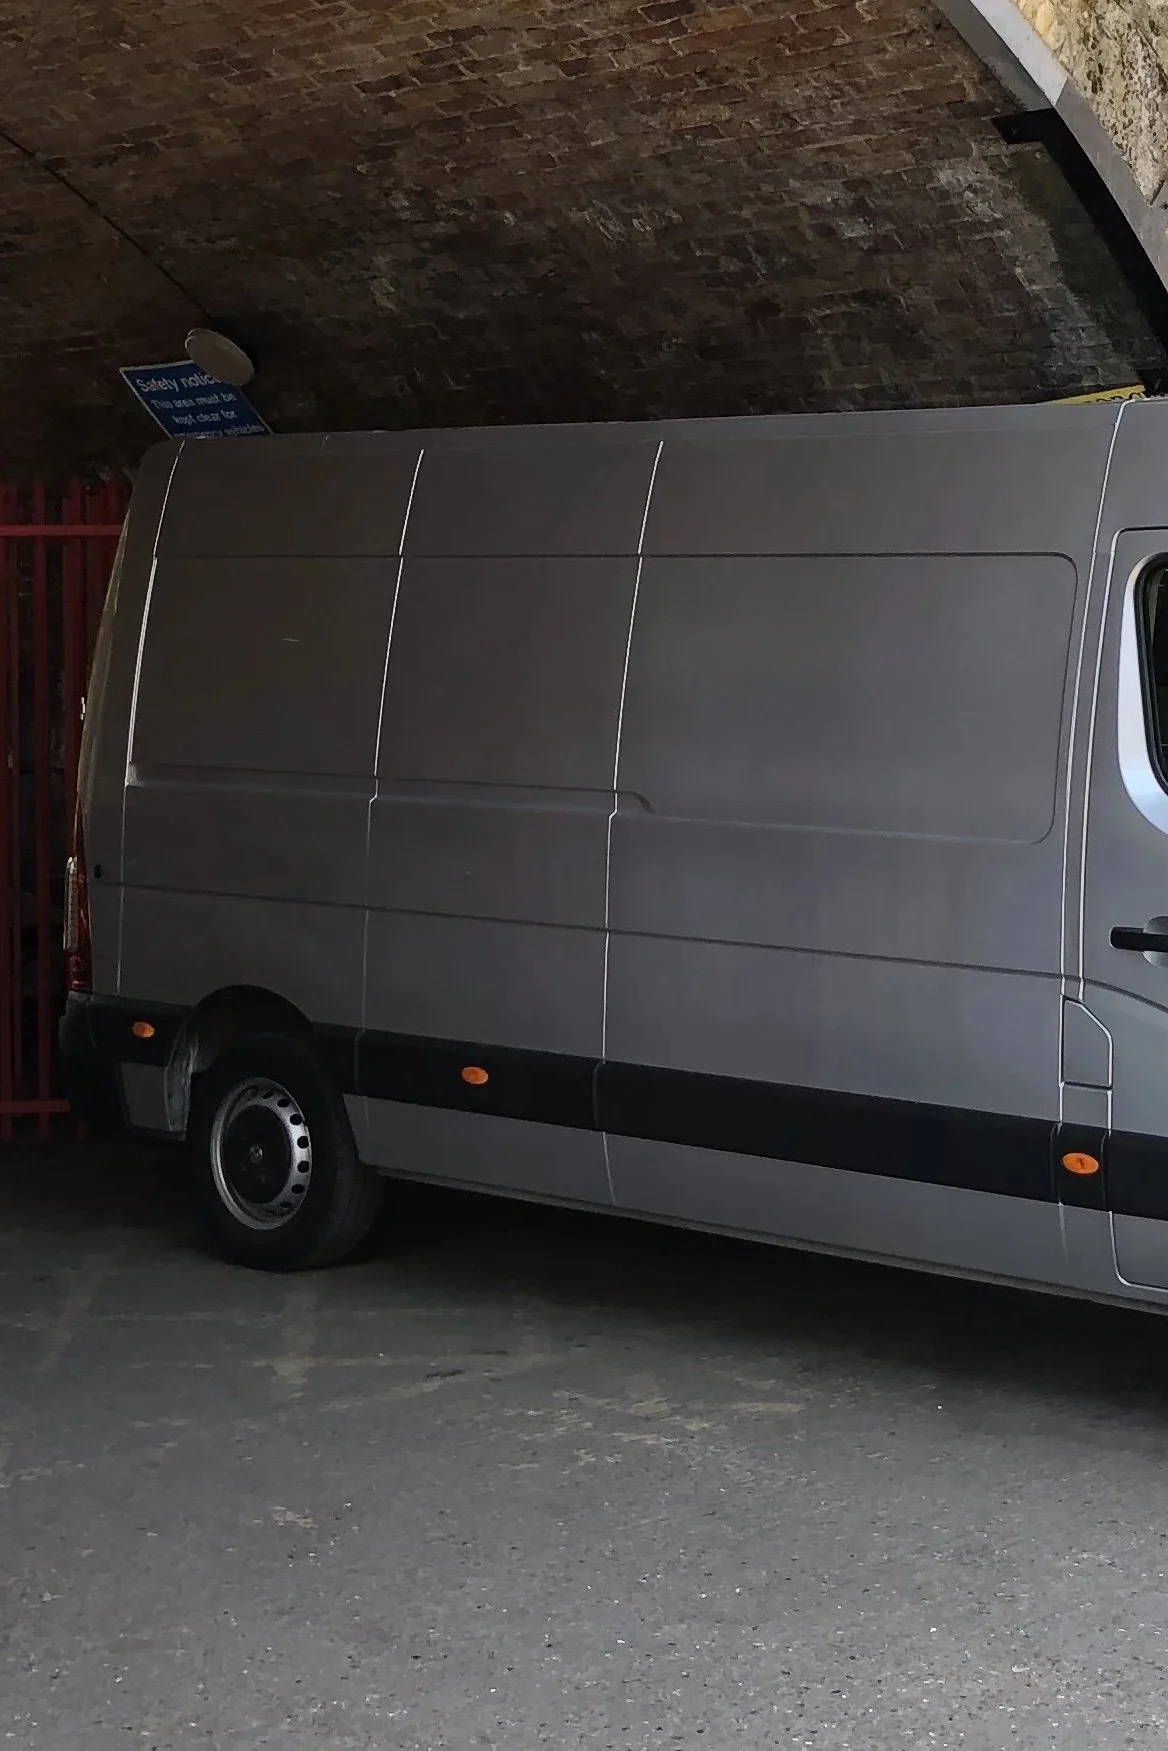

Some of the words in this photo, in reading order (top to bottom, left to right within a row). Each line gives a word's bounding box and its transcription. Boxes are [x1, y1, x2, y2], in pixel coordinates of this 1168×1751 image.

[136, 376, 180, 392] Safety
[173, 398, 195, 408] area
[195, 393, 220, 406] must
[220, 392, 237, 402] be
